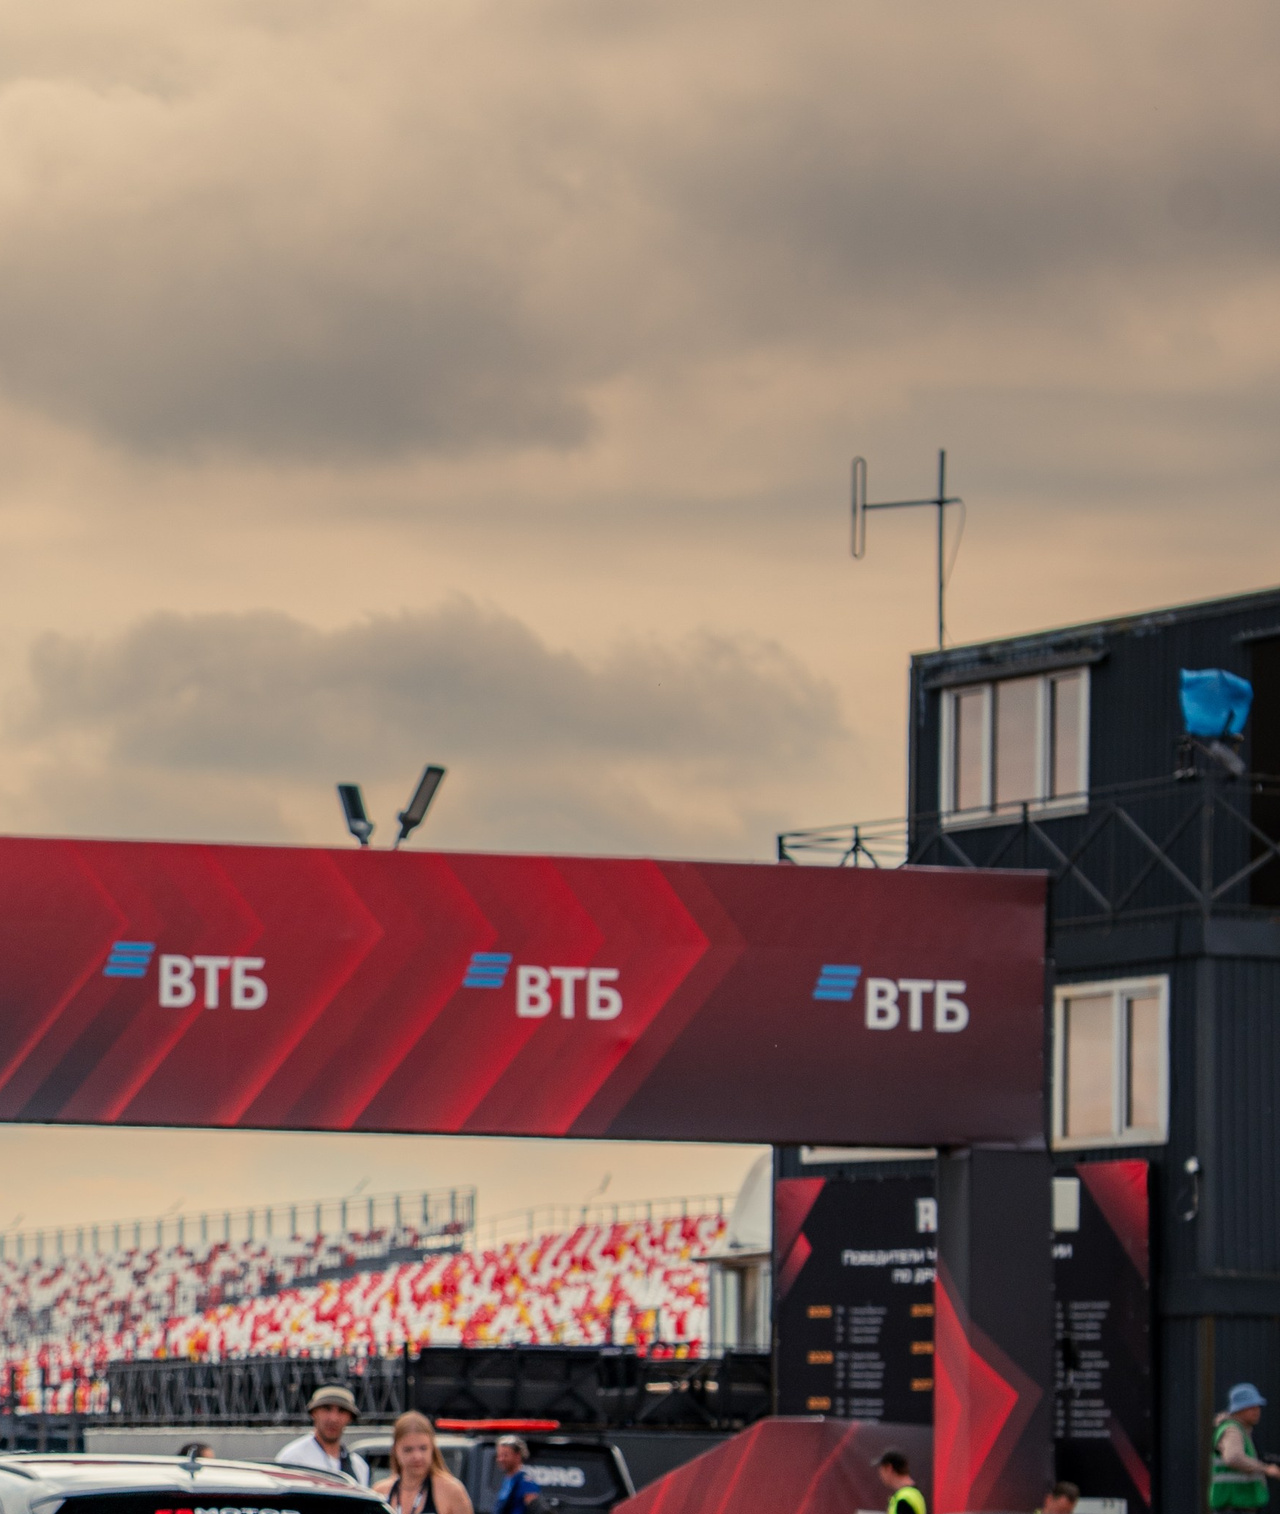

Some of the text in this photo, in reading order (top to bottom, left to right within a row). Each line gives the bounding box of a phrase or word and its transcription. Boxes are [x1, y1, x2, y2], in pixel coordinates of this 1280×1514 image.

[158, 956, 268, 1010] ВТБ
[515, 967, 623, 1021] ВТБ
[864, 978, 970, 1033] ВТБ
